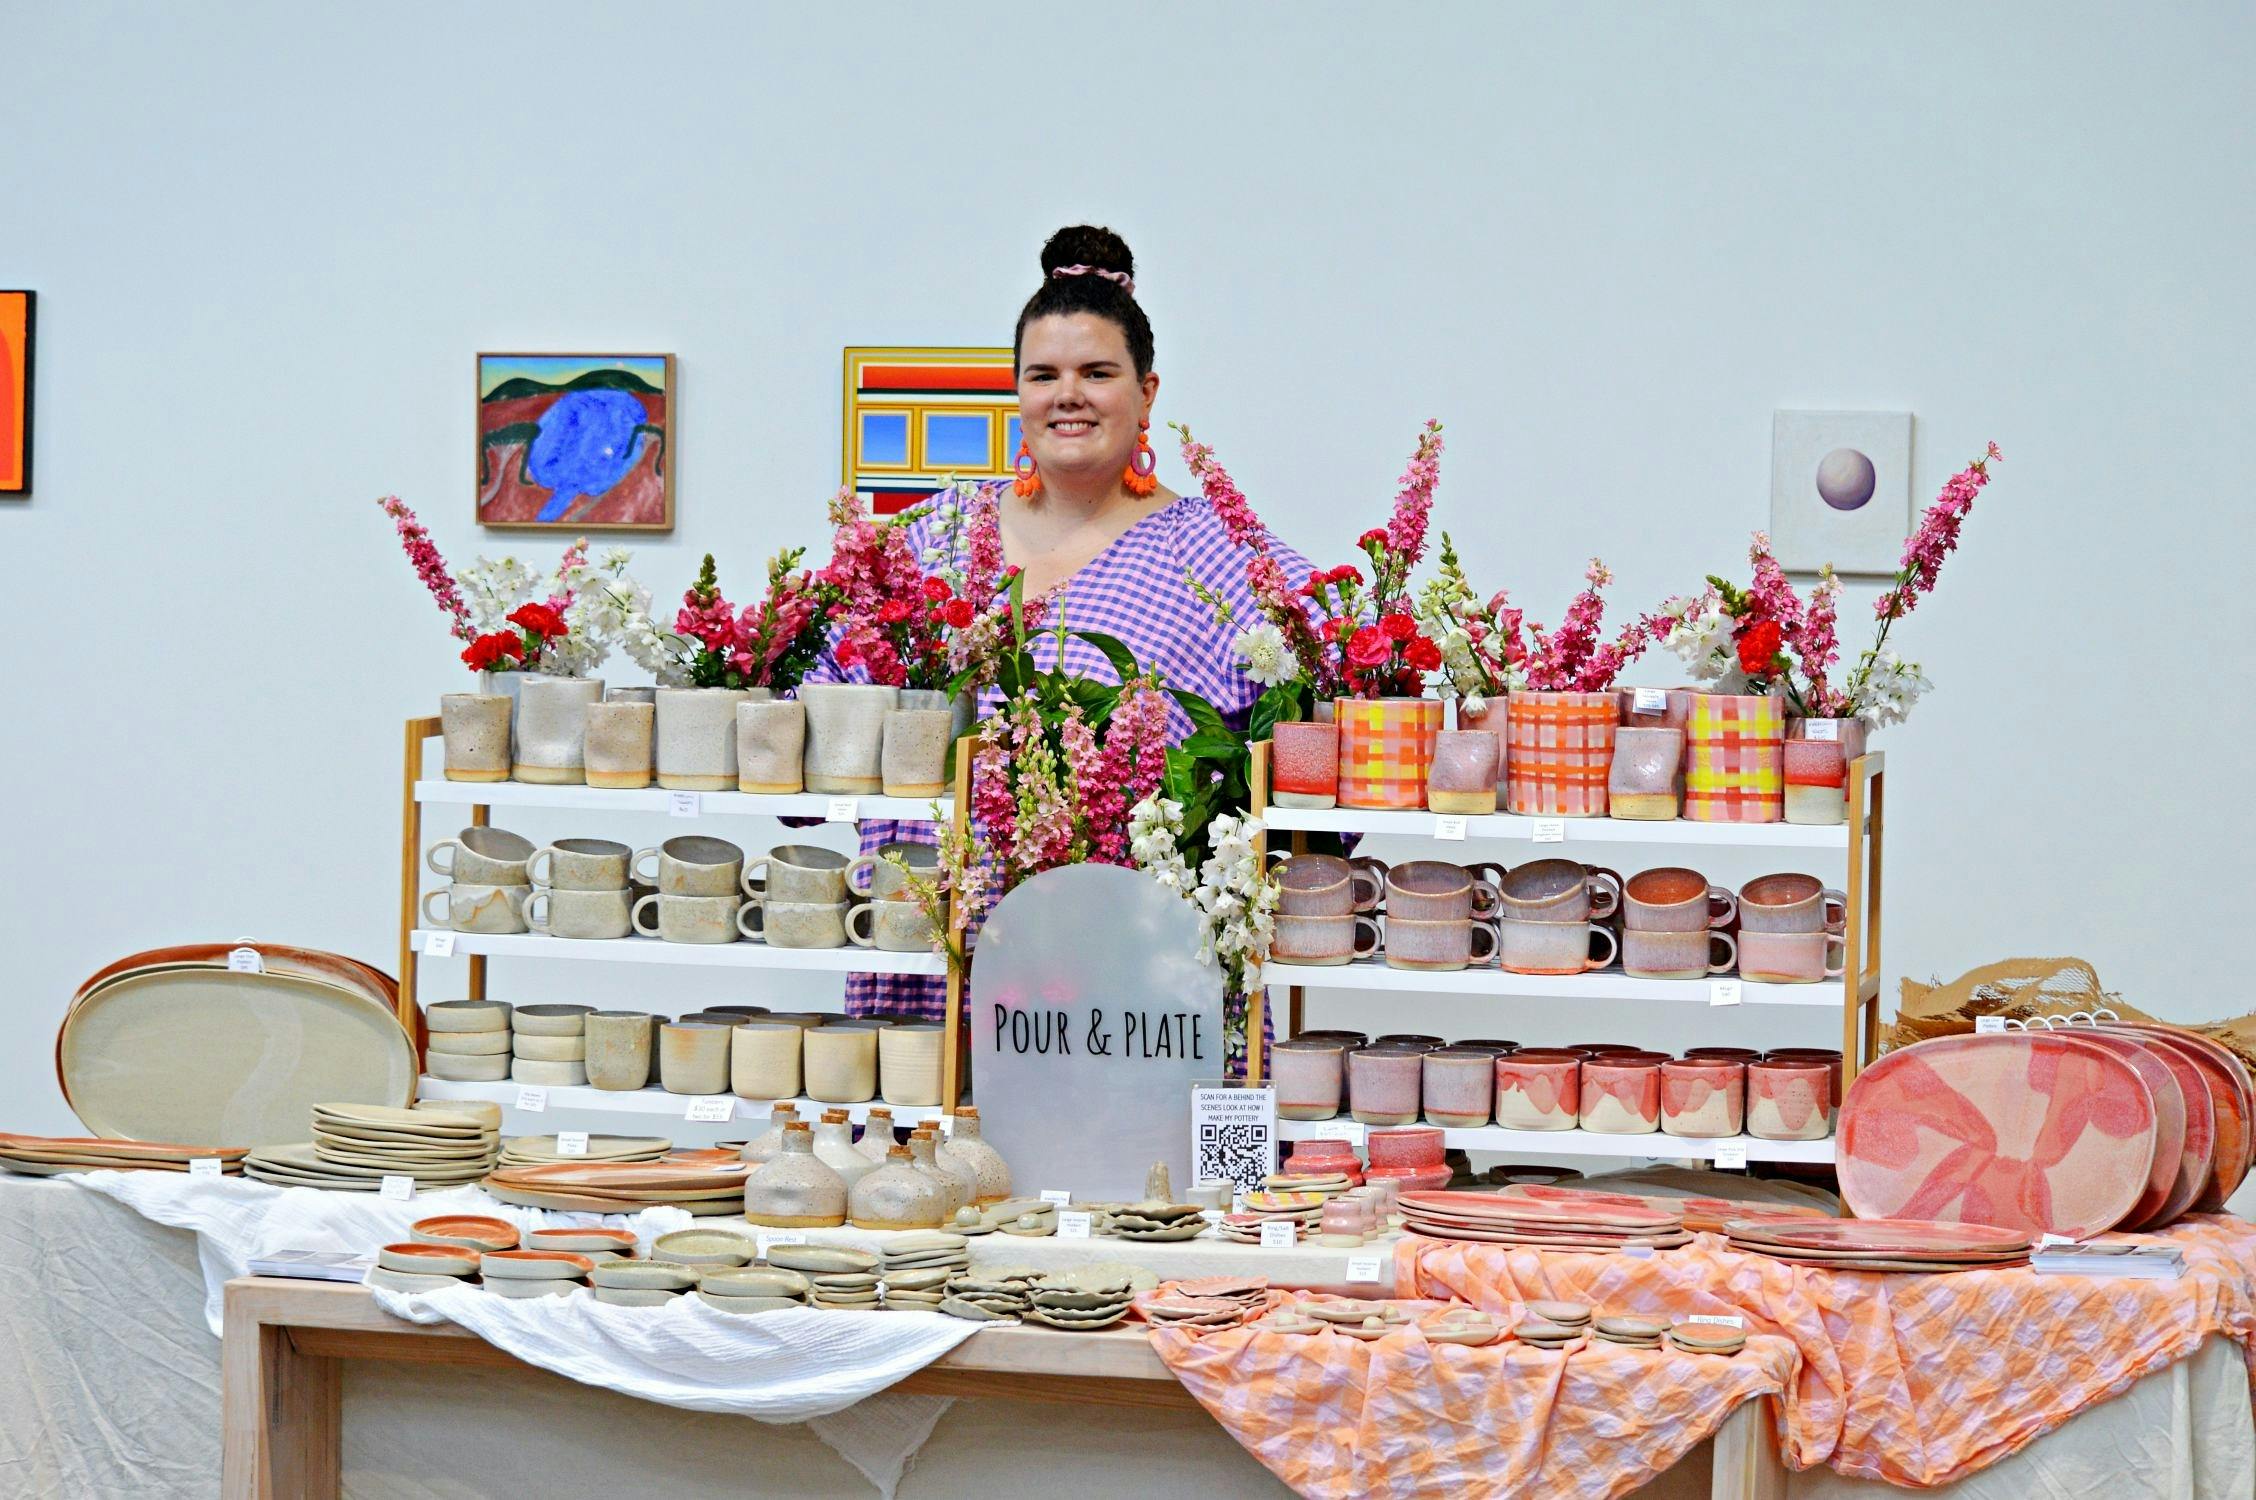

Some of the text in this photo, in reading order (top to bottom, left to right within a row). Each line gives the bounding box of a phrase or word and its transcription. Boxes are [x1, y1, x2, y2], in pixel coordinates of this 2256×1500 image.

[1086, 1008, 1112, 1056] &
[1124, 1011, 1204, 1060] PLATE
[1200, 1093, 1215, 1101] SCAN
[1215, 1093, 1228, 1101] FOR
[1233, 1093, 1255, 1101] BEHIND
[1255, 1093, 1267, 1101] THE
[1207, 1114, 1259, 1122] MAKE MY POTTERY
